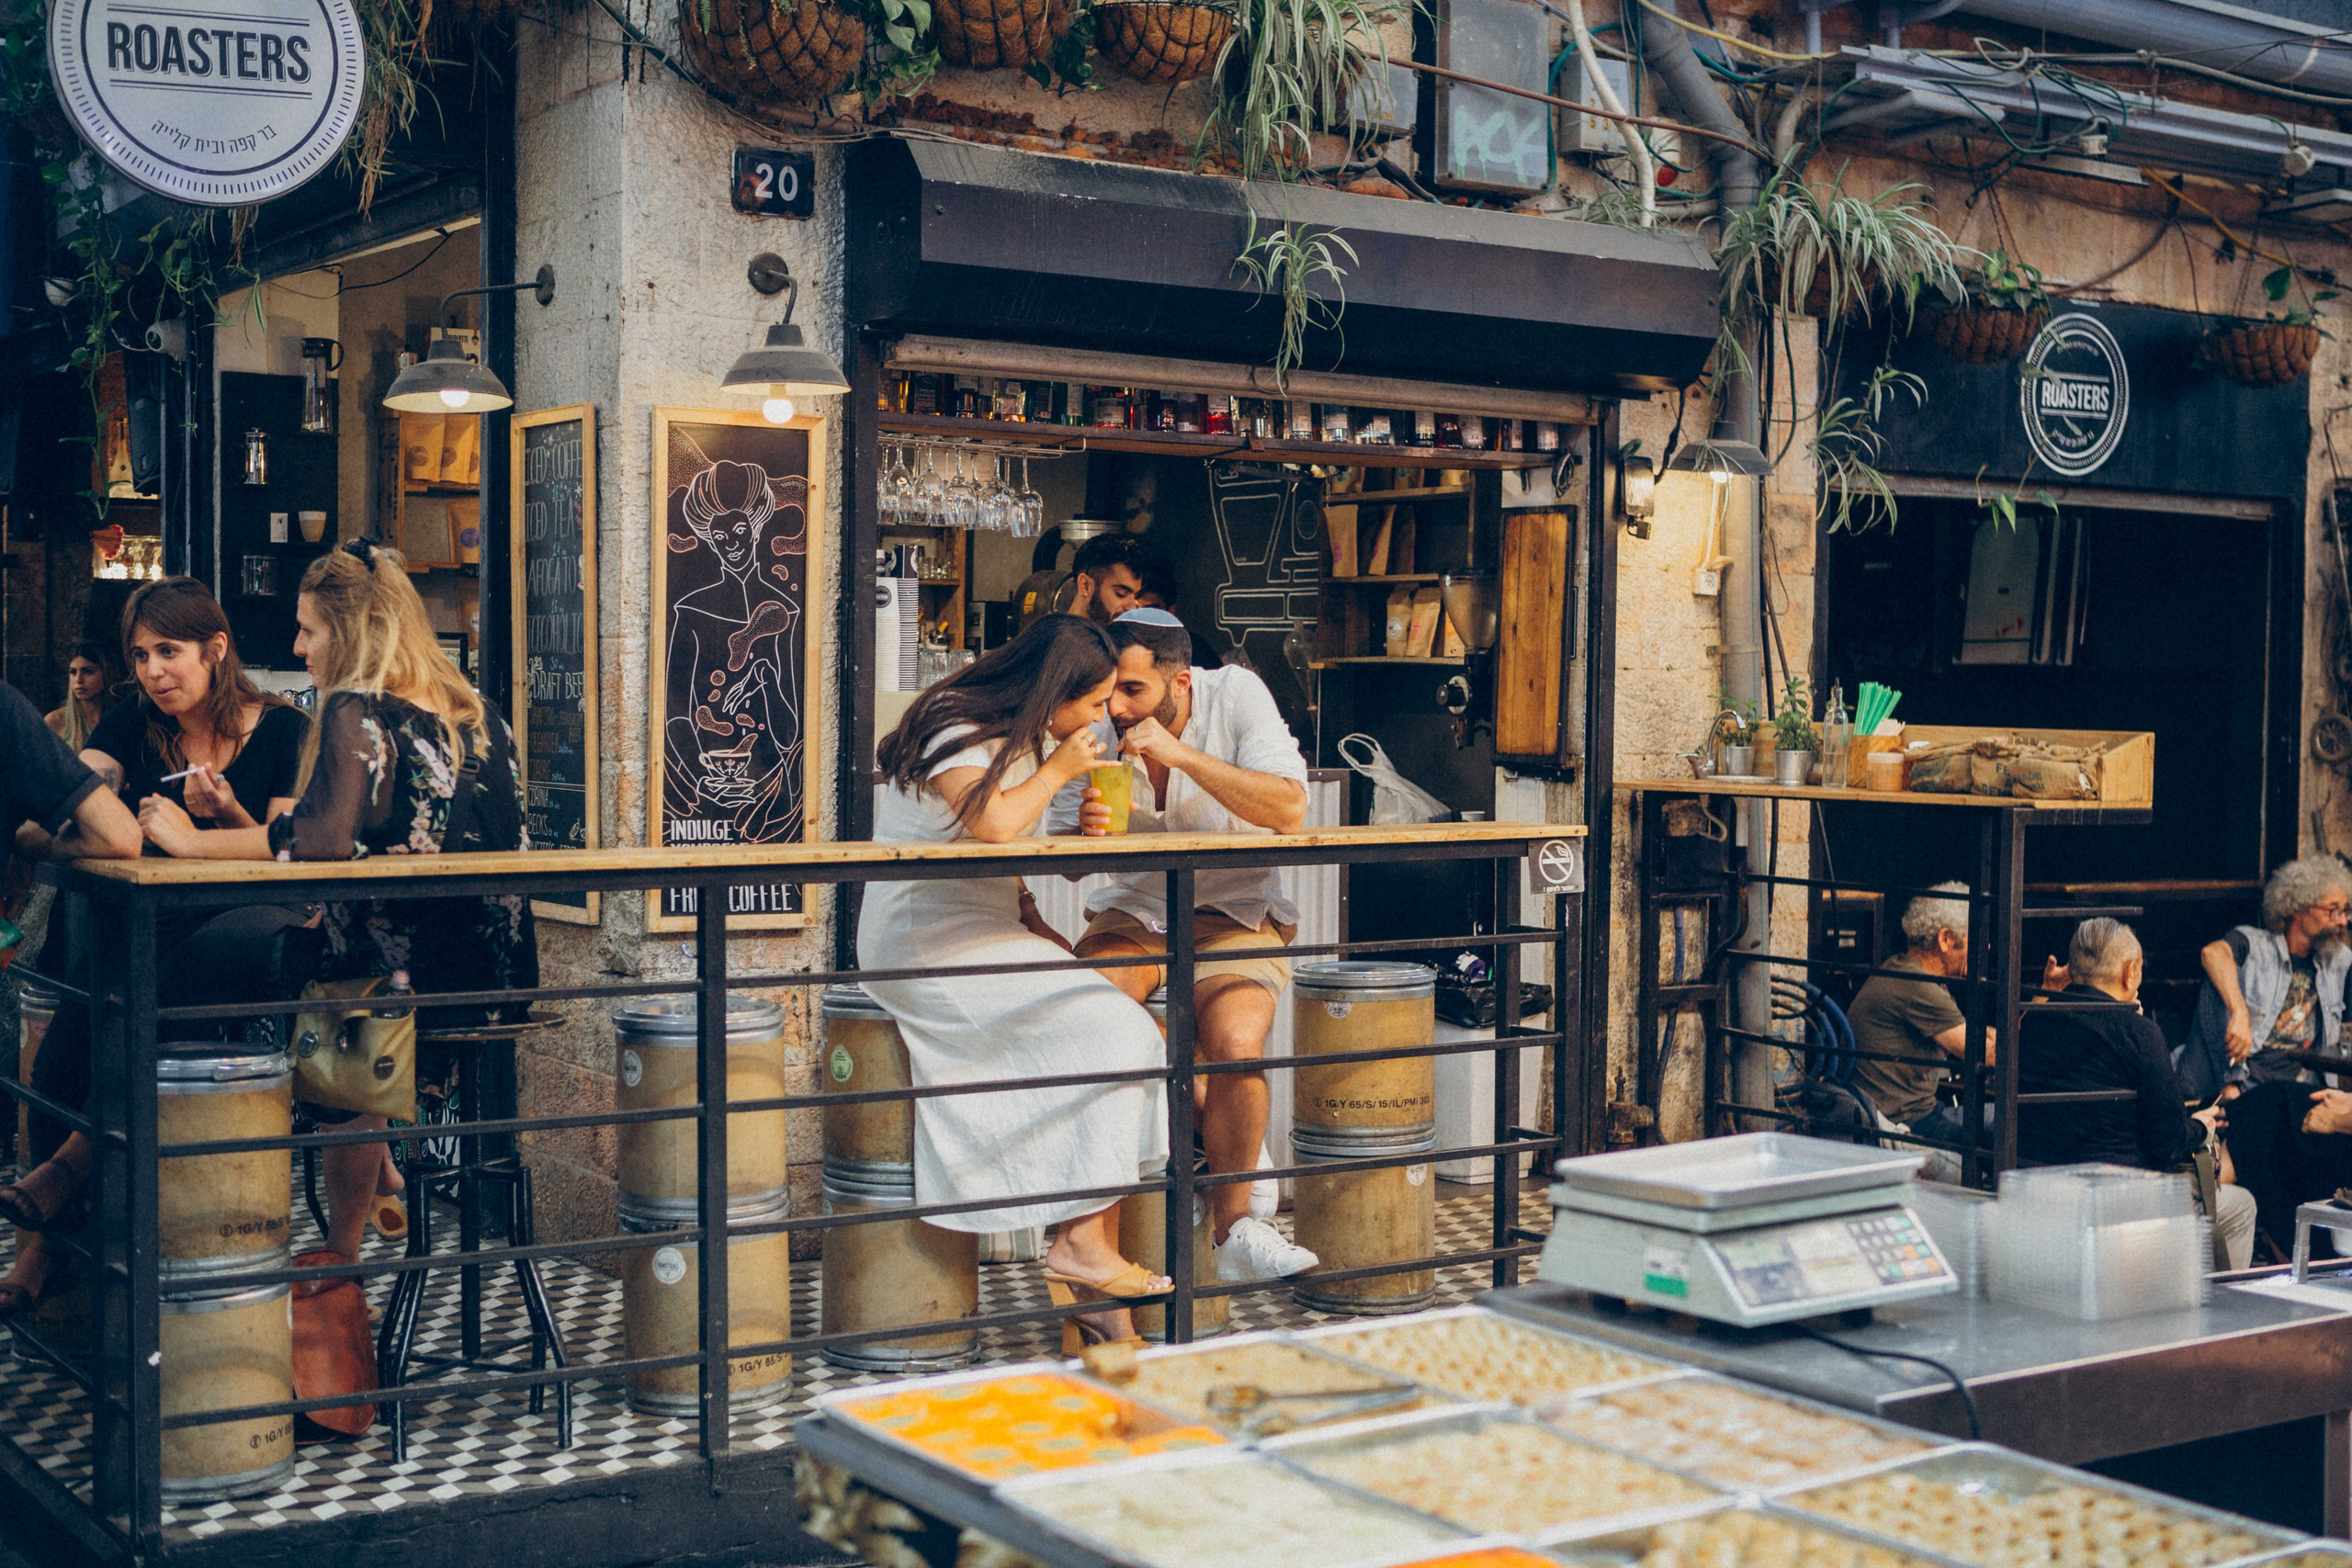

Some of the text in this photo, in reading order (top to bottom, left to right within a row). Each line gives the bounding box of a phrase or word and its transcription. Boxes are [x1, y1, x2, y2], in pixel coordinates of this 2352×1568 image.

[107, 21, 311, 84] ROASTERS
[151, 119, 277, 154] בר קפה ובית קלייה
[755, 163, 798, 202] 20
[2041, 379, 2110, 412] ROASTERS
[526, 439, 582, 486] ICED COFFE
[526, 496, 576, 542] ICED TEA
[533, 671, 561, 700] DRAFT
[670, 819, 734, 840] INDULGE
[729, 884, 793, 912] COFFEE
[739, 1359, 763, 1373] 1G/Y
